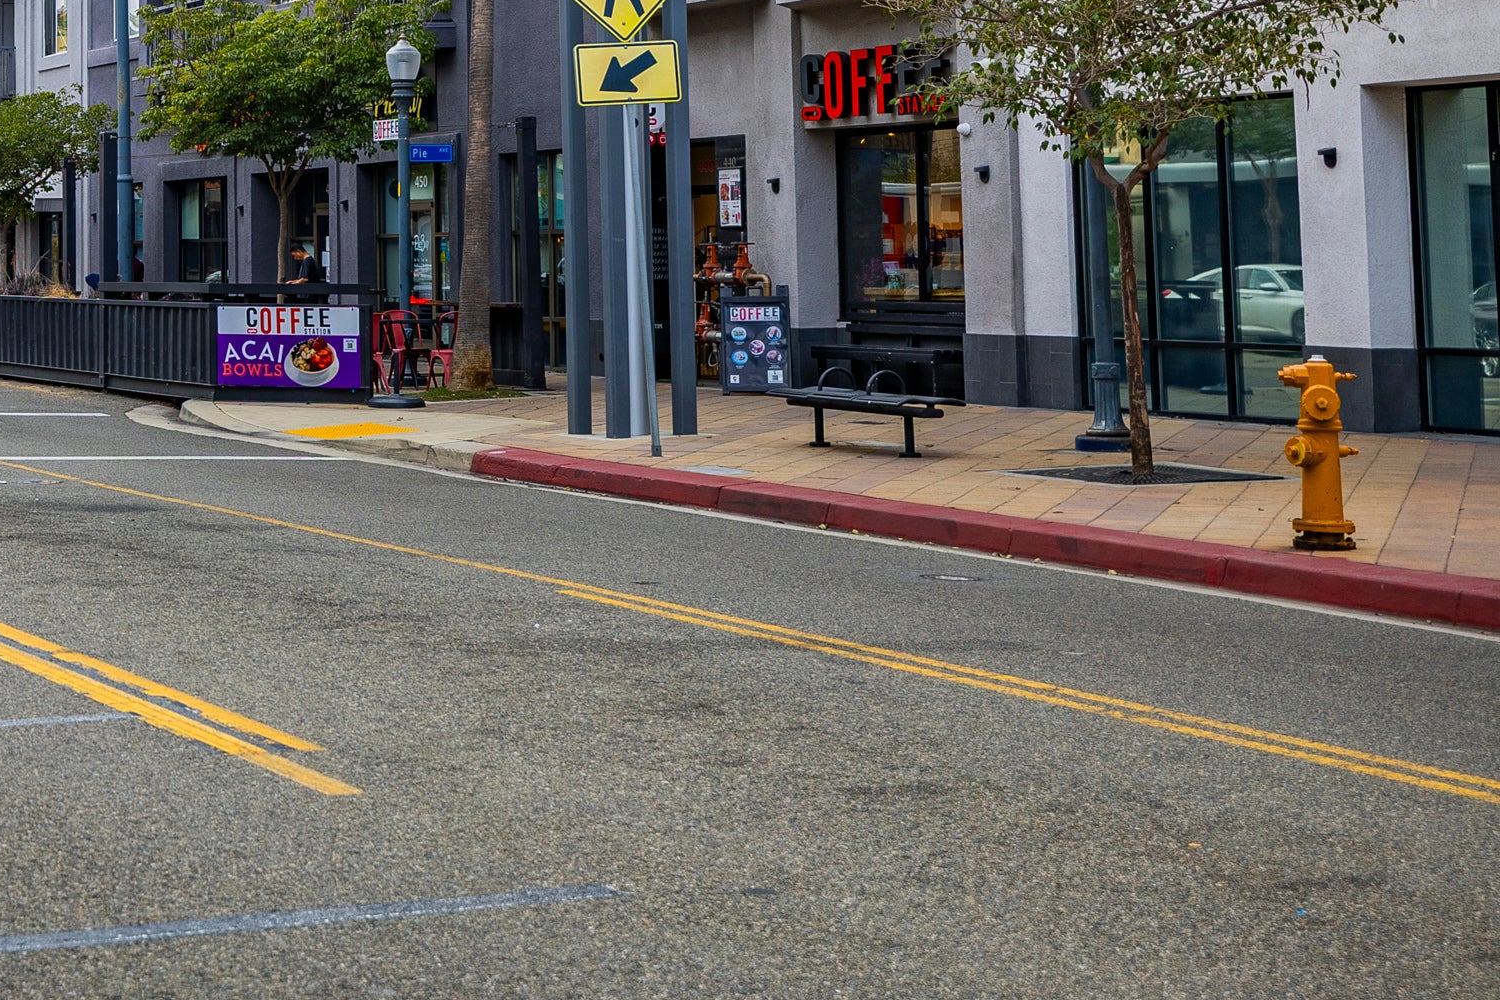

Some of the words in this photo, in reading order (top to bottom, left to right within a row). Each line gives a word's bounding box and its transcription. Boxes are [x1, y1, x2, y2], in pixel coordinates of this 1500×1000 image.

[412, 148, 428, 158] Pie
[414, 175, 428, 188] 450
[731, 307, 779, 320] COFFEE
[246, 307, 331, 334] COFFEE
[225, 340, 285, 364] ACAI
[222, 363, 284, 377] BOWLS
